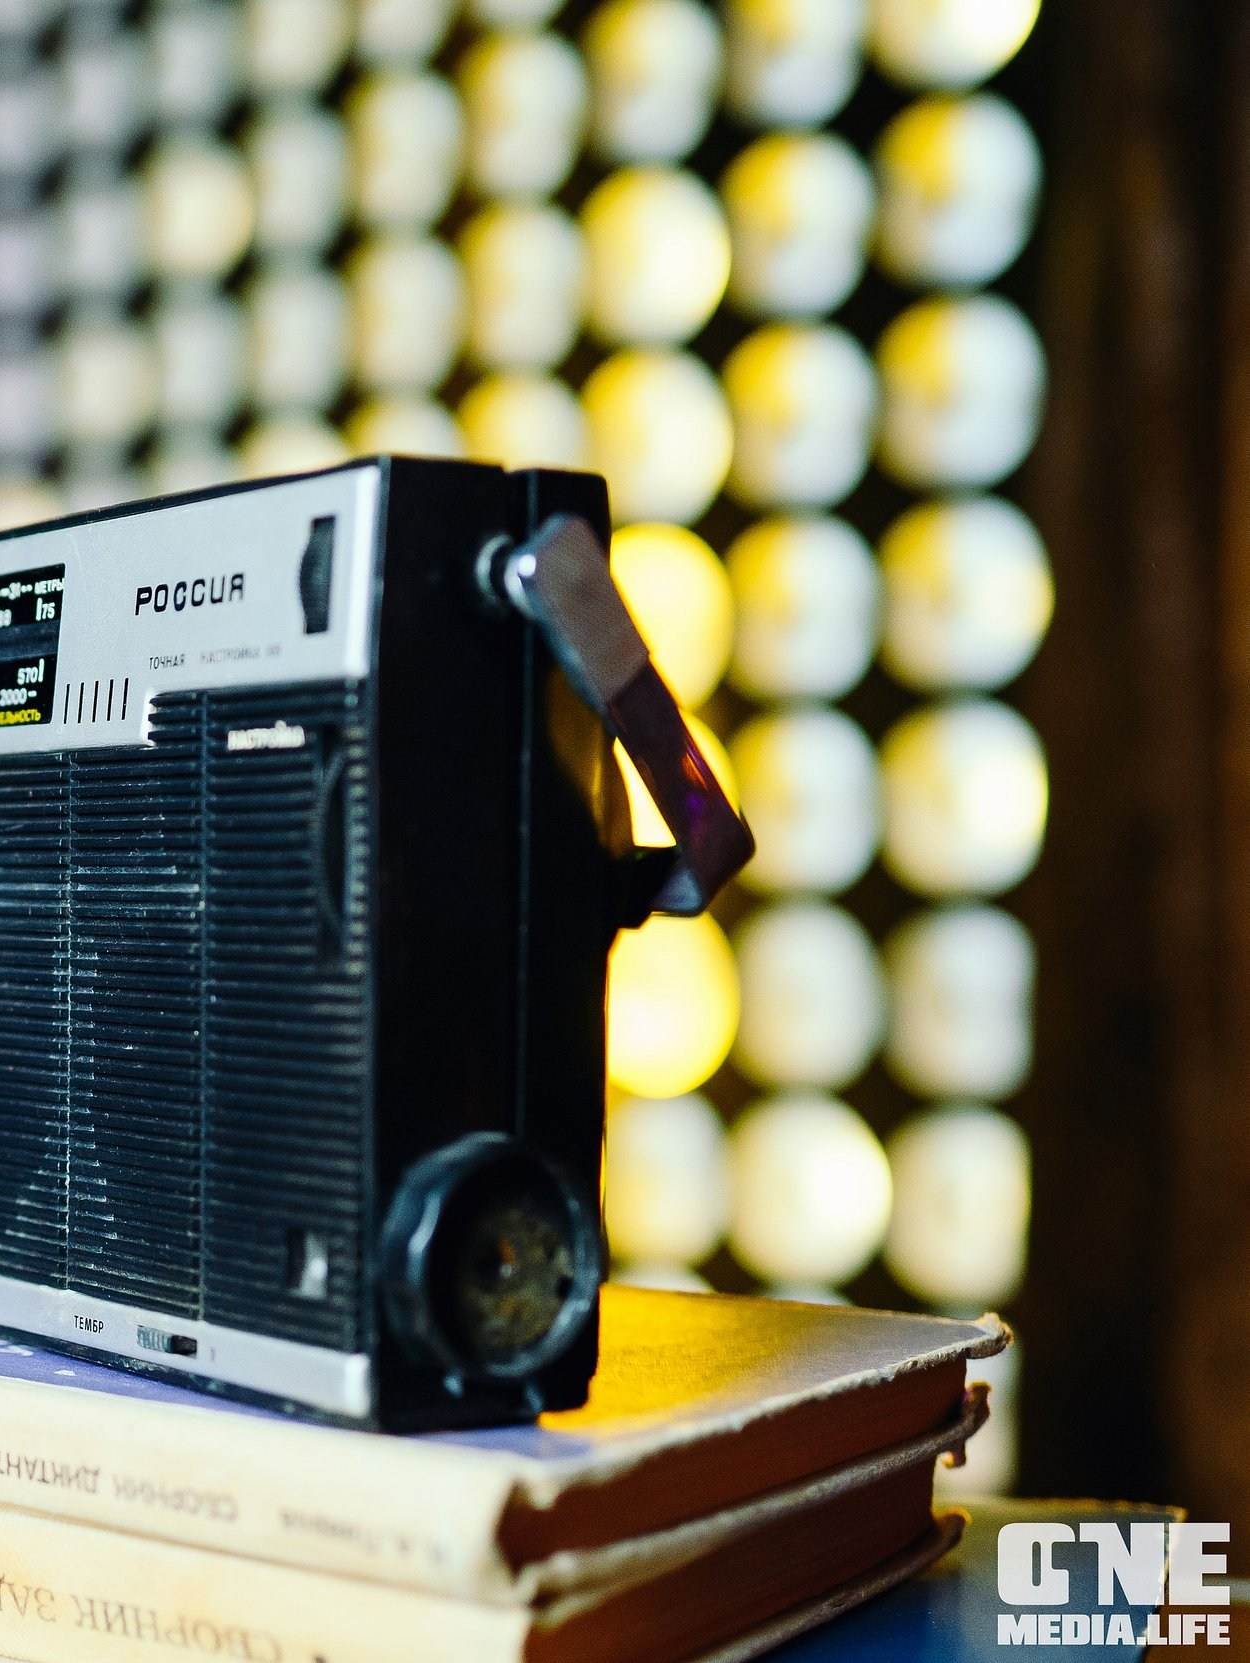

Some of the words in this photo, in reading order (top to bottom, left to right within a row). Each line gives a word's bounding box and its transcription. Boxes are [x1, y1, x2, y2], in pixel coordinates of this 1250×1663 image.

[135, 572, 245, 616] РОССИЯ
[149, 653, 186, 671] ТОЧНАЯ
[74, 1315, 104, 1334] ТЕМБР
[112, 1473, 241, 1524] СБОРНИК
[68, 1593, 285, 1663] СБОРНИК
